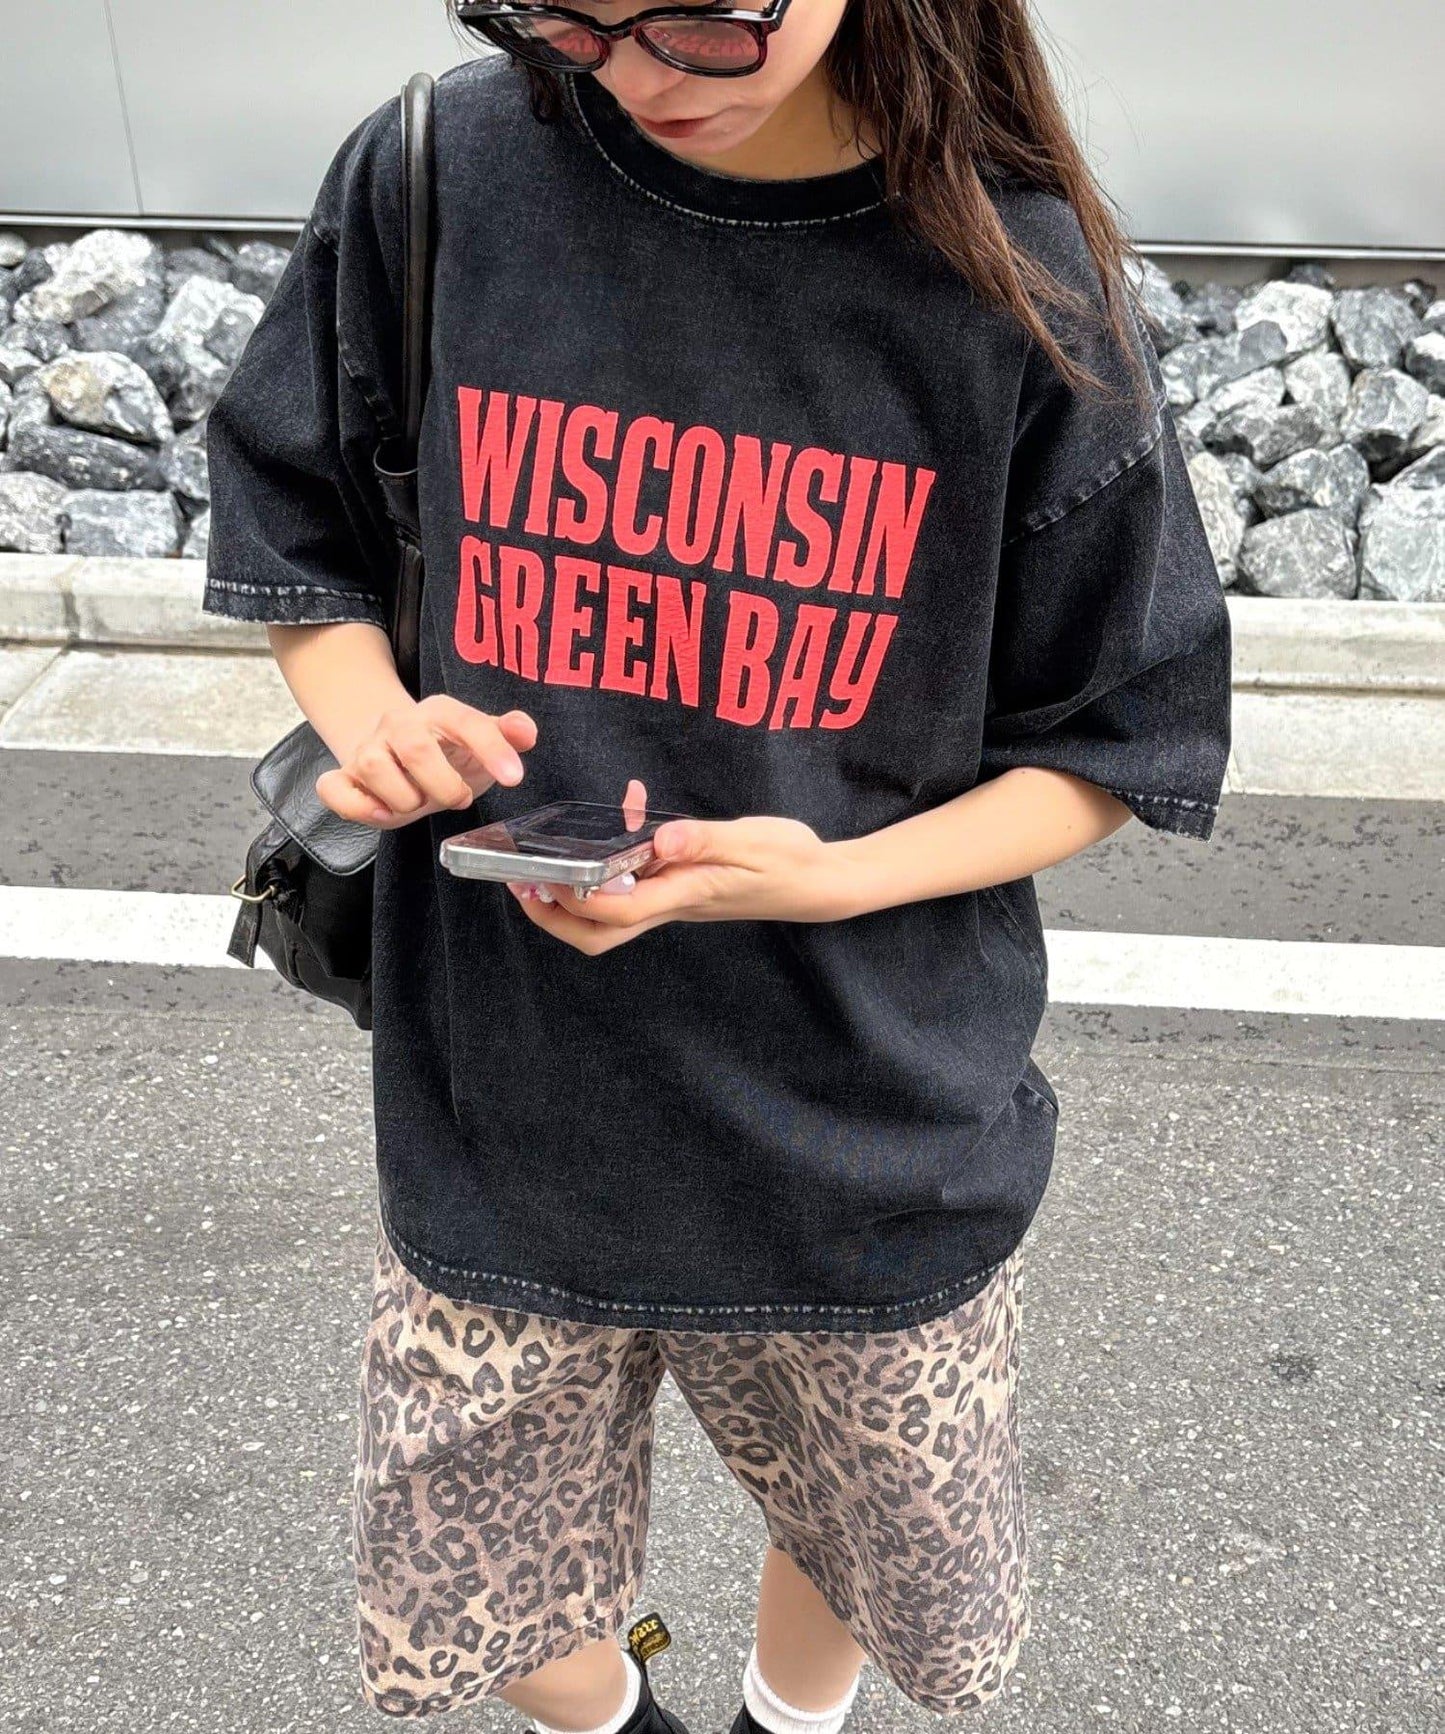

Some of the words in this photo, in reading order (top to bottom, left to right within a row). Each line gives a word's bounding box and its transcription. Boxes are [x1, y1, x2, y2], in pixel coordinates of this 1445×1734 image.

[458, 387, 936, 598] WISCONSIN
[454, 535, 706, 707] GREEN
[716, 591, 898, 730] BAY
